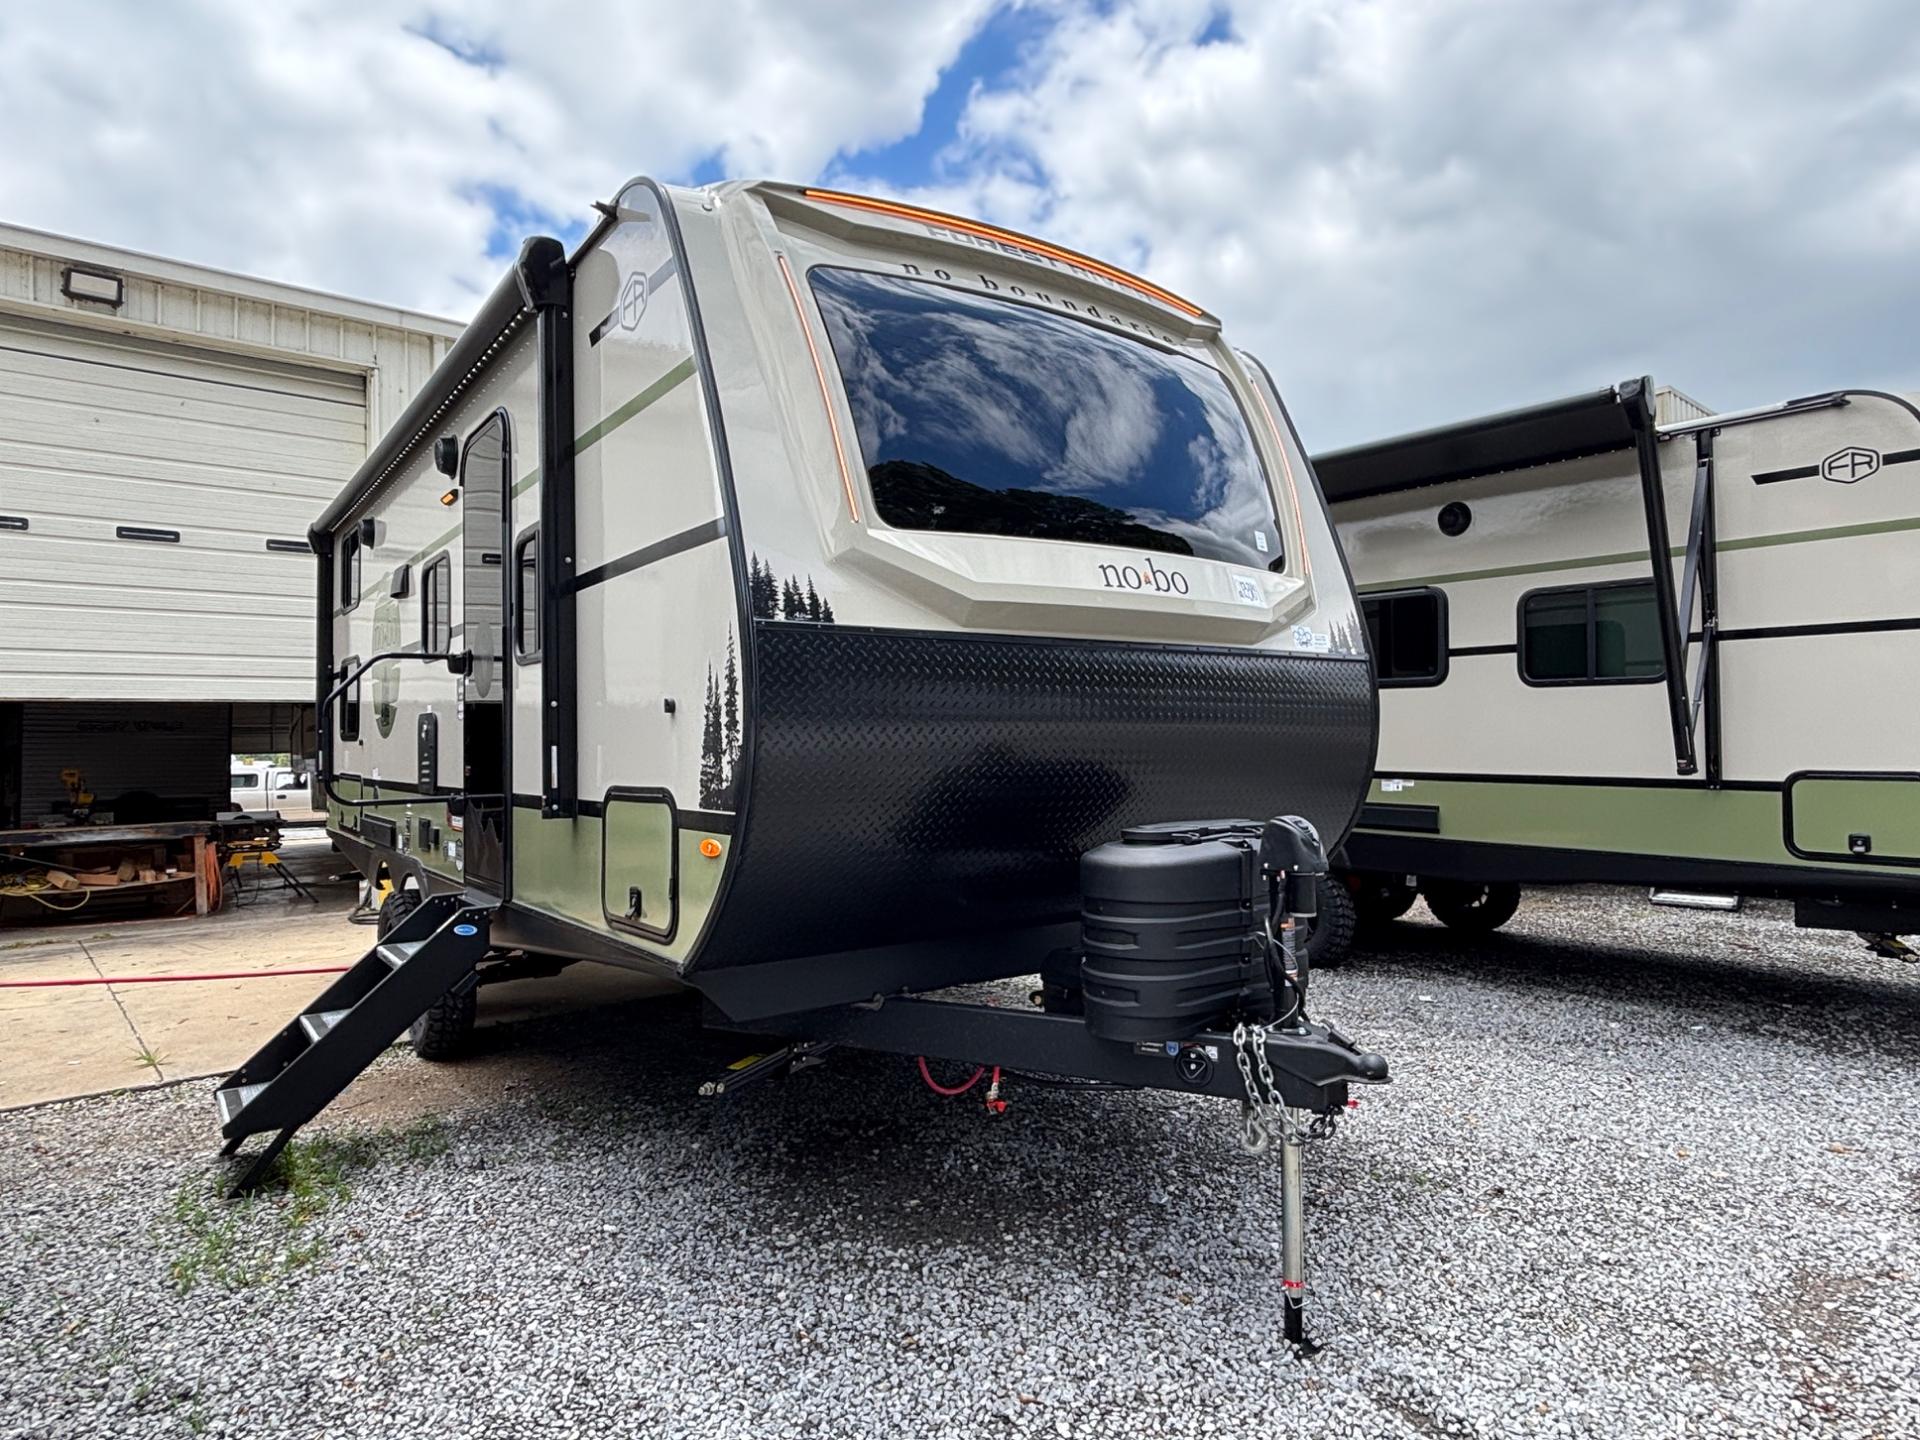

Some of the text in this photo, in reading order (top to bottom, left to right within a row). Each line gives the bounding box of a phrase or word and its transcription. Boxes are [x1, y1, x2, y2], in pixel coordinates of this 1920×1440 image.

[901, 263, 1175, 345] no boundarie
[1827, 452, 1874, 478] FR
